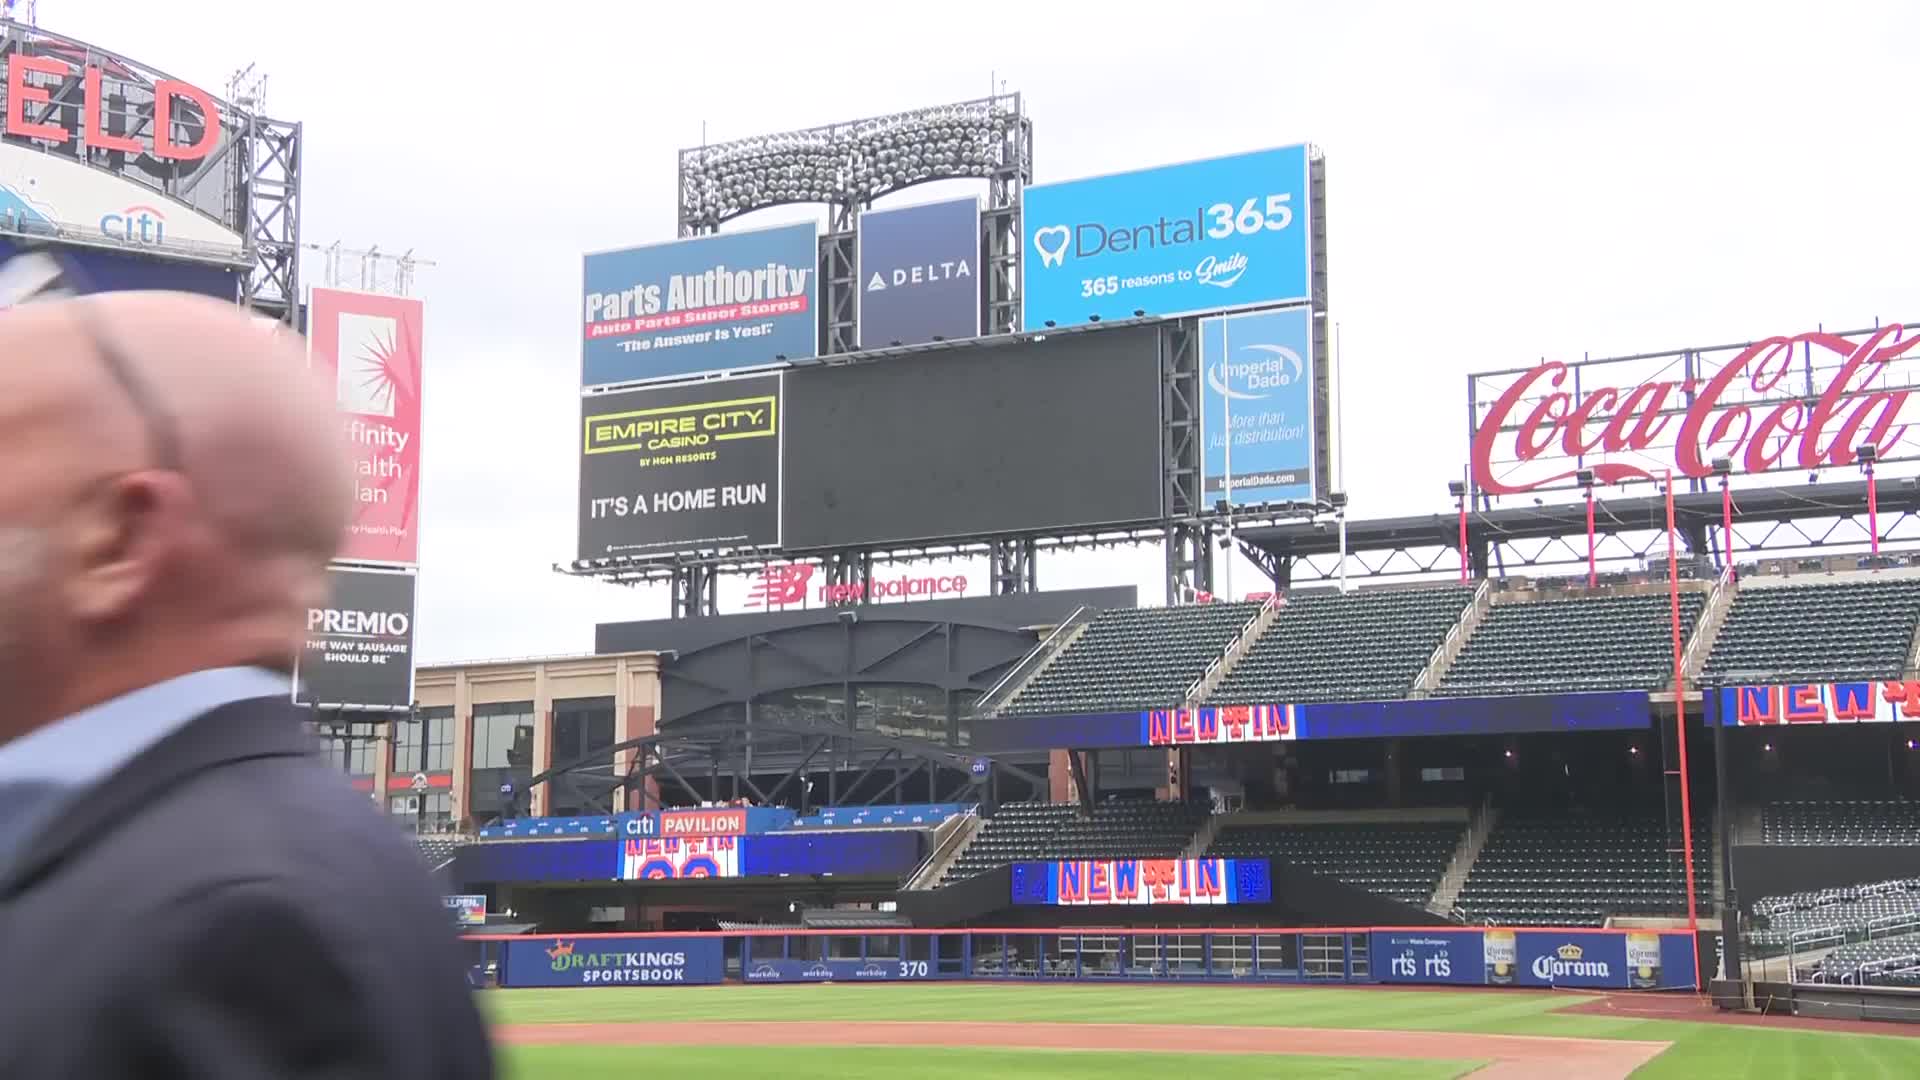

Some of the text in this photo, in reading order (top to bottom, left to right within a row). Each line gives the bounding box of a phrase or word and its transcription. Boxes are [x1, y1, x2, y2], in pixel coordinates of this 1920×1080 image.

[101, 210, 165, 242] citi
[893, 260, 970, 286] DELTA
[1081, 253, 1248, 298] 365 reasons to Smile
[586, 263, 806, 322] Parts Authority
[592, 300, 800, 336] Auto Parts Super Stores
[654, 333, 712, 348] Answer
[715, 329, 730, 341] Is
[1220, 357, 1283, 379] Imperial
[1248, 373, 1290, 389] Dade
[596, 416, 696, 442] EMPIRE
[1210, 431, 1229, 448] jus
[647, 433, 710, 450] CASINO
[640, 458, 651, 467] BY
[675, 451, 717, 464] RESORTS
[591, 482, 767, 519] IT'S A HOME RUN
[819, 575, 967, 601] new balance
[306, 608, 408, 636] PREMIO
[307, 640, 407, 654] THE WAY SAUSAGE
[324, 653, 387, 665] SHOULD BE
[1737, 682, 1876, 725] NEW
[626, 815, 654, 834] citi
[664, 816, 740, 833] PAVILION
[1059, 860, 1140, 901] NEW
[551, 952, 686, 971] DRAFTKINGS
[899, 961, 928, 977] 370
[1391, 953, 1451, 976] rts rts
[1532, 955, 1610, 981] Corona
[583, 969, 684, 982] SPORTSBOOK
